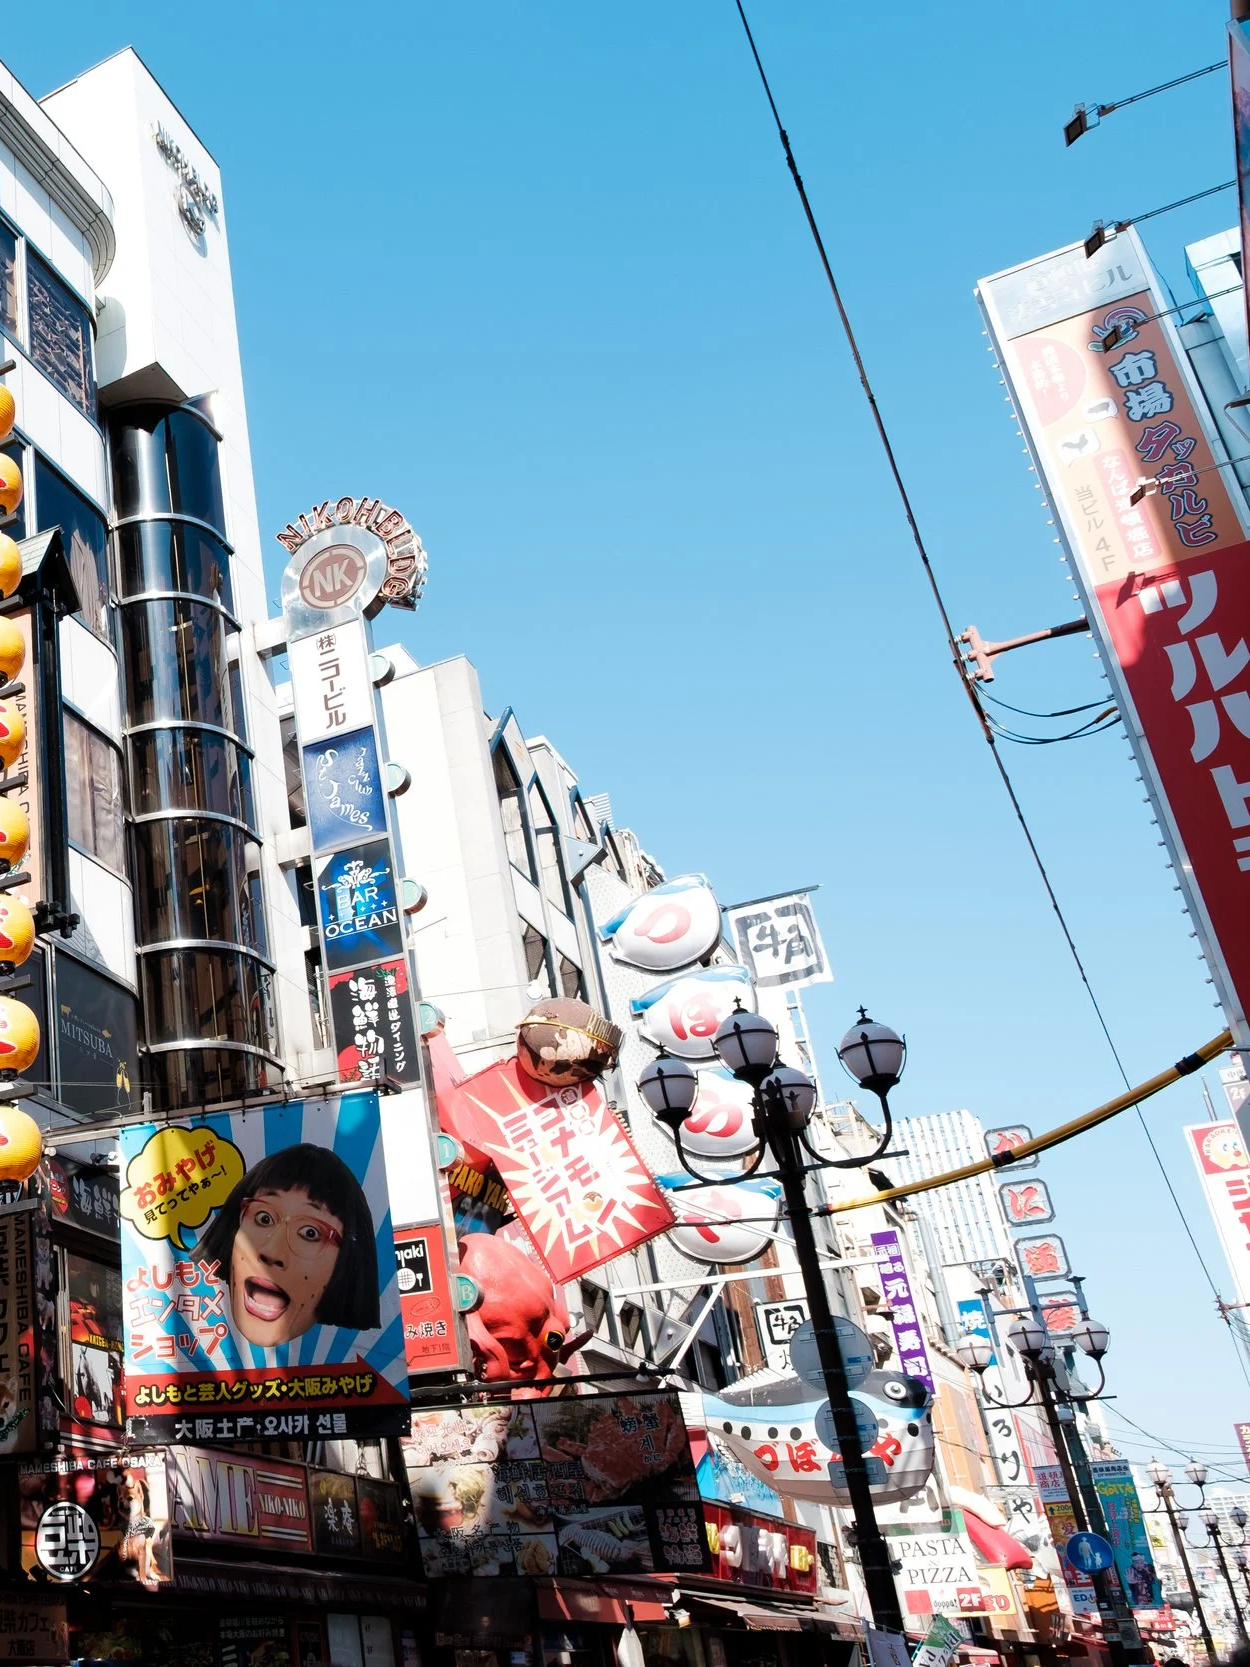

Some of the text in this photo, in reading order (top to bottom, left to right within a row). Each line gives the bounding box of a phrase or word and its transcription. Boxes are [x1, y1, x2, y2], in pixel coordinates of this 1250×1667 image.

[1109, 350, 1218, 548] 市場タッカルビ
[276, 496, 379, 552] NIKOH
[312, 558, 355, 599] NK
[324, 779, 370, 824] James
[337, 885, 379, 911] BAR
[325, 908, 399, 940] OCEAN
[60, 1019, 113, 1058] MITSUBA
[133, 1139, 217, 1209] おみやげ
[126, 1258, 222, 1293] よしもと
[129, 1289, 224, 1328] エンタメ
[128, 1322, 229, 1361] ショップ
[17, 1343, 32, 1402] CAFE
[20, 1453, 164, 1475] MAMESHIBA CAFE OSAKA
[752, 1430, 902, 1474] づぼや
[899, 1537, 967, 1558] PASTA
[907, 1565, 974, 1585] PIZZA
[958, 1593, 981, 1607] 2F
